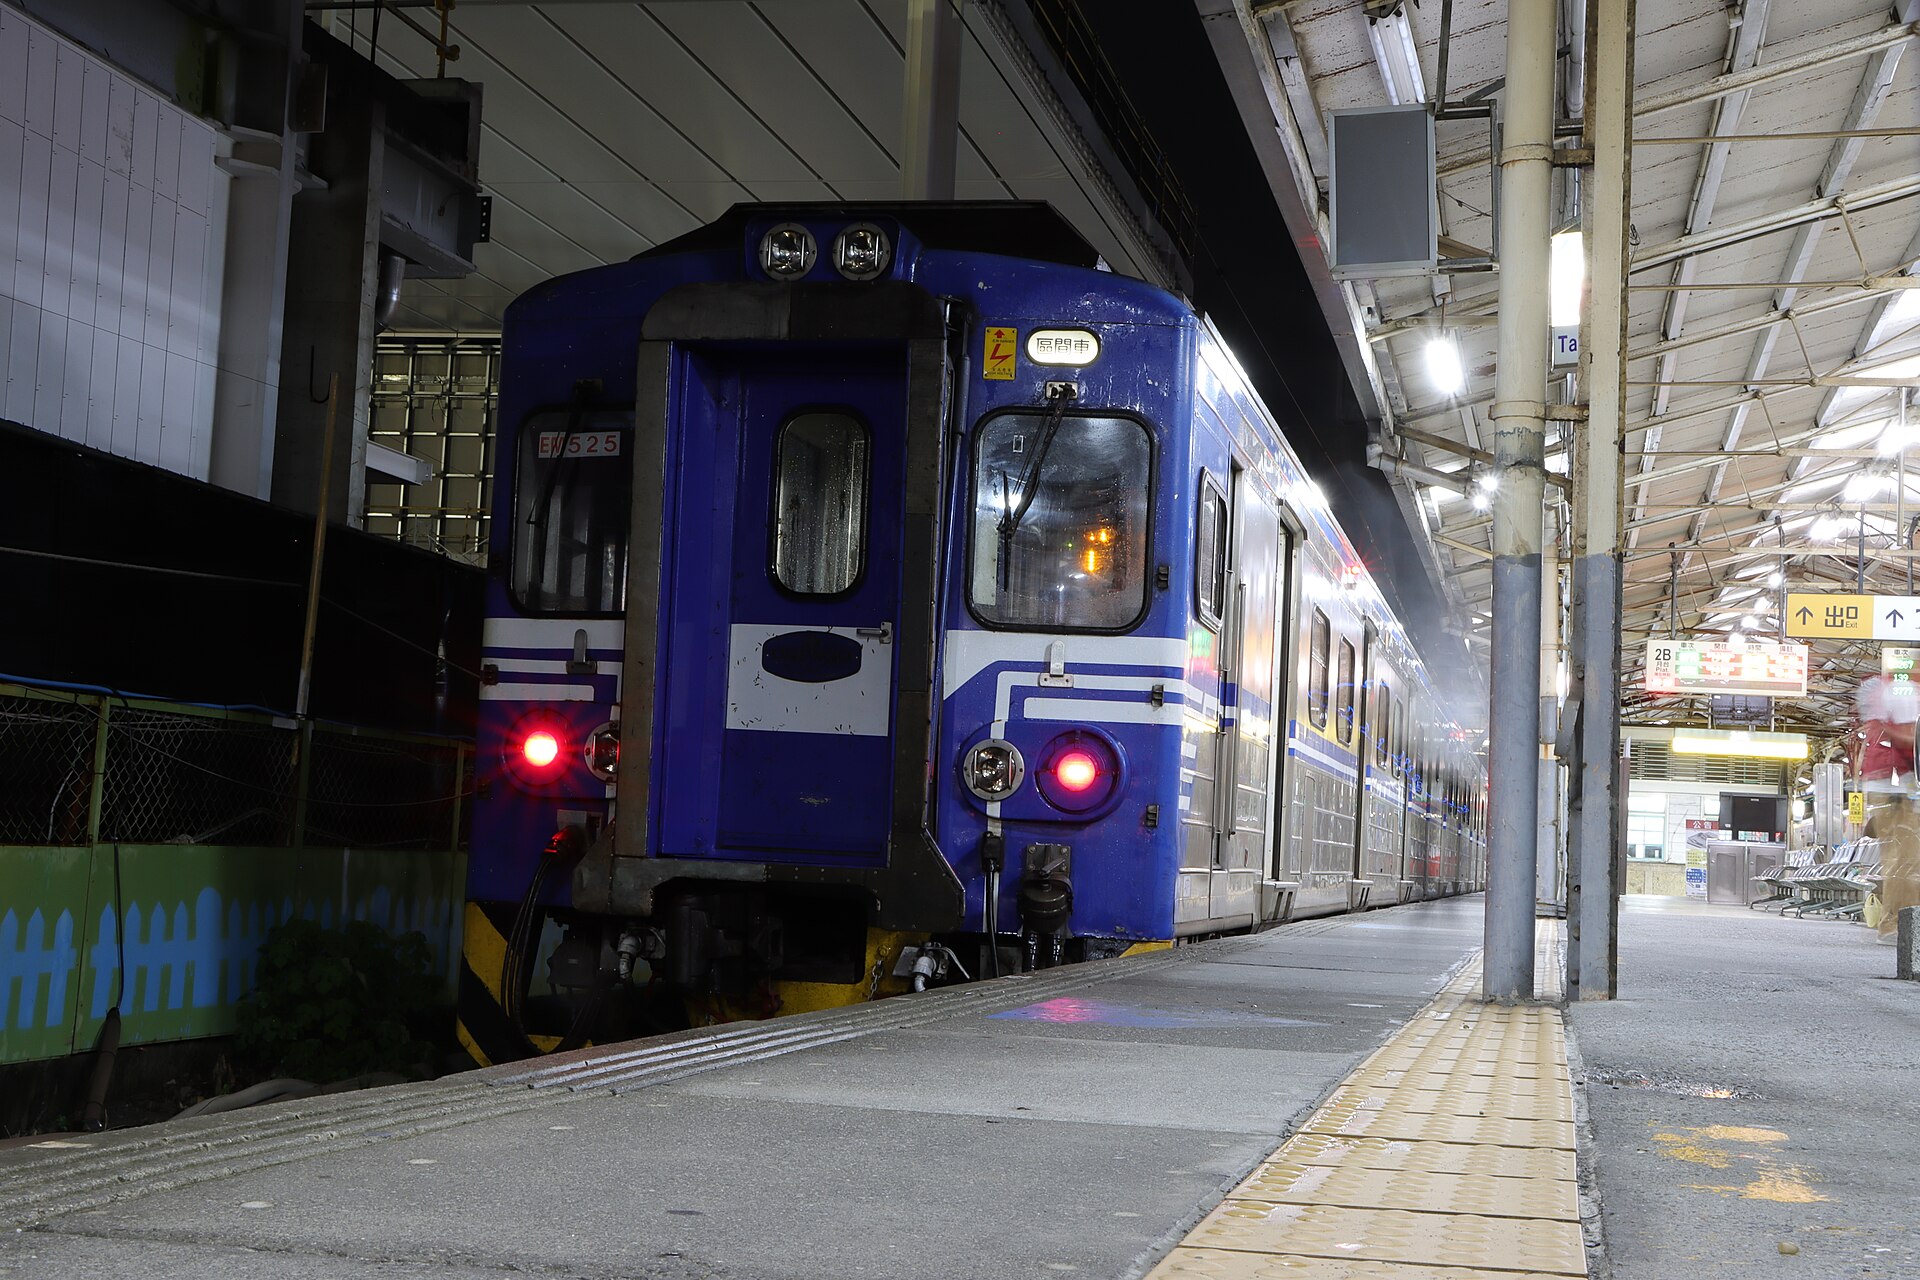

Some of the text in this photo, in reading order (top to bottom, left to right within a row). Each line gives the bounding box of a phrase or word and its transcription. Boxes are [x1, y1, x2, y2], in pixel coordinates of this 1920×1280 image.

[1037, 338, 1089, 354] 區間車
[1825, 605, 1858, 627] 出口
[1655, 648, 1671, 661] 2B
[1893, 673, 1909, 682] 139
[1693, 821, 1712, 829] 公告
